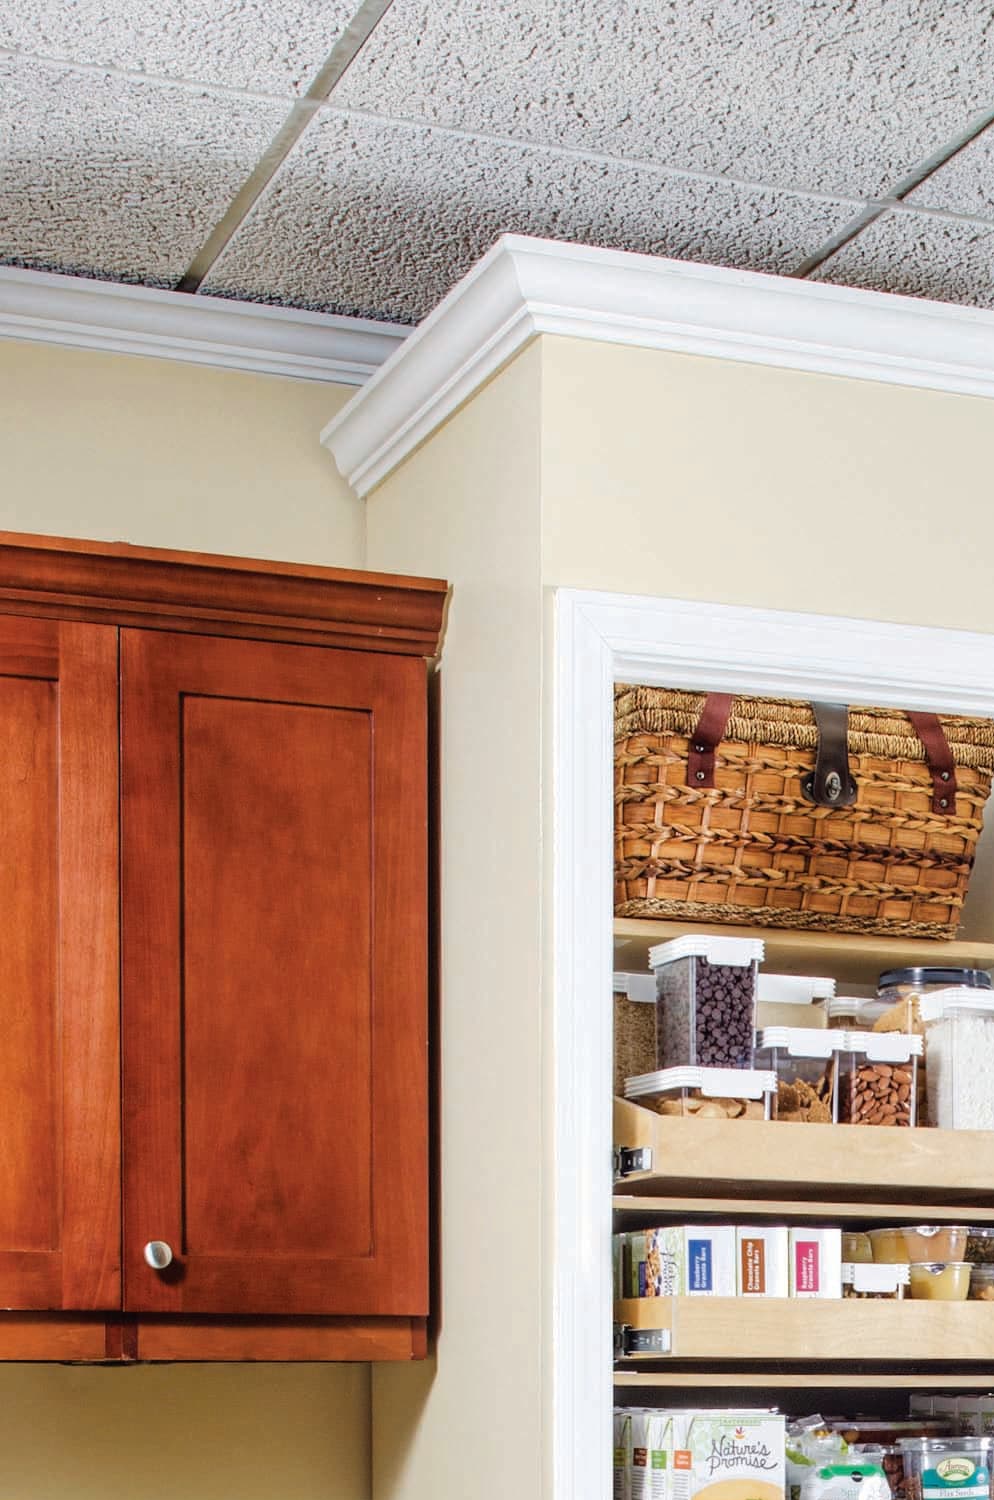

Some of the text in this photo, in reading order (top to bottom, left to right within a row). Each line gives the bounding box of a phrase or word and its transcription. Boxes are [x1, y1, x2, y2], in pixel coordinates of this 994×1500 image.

[747, 1241, 755, 1257] Chip
[693, 1255, 701, 1289] Blueberry
[700, 1262, 708, 1289] Granola
[801, 1256, 809, 1290] Raspberry
[711, 1435, 771, 1457] Nature's
[705, 1455, 778, 1476] Promise
